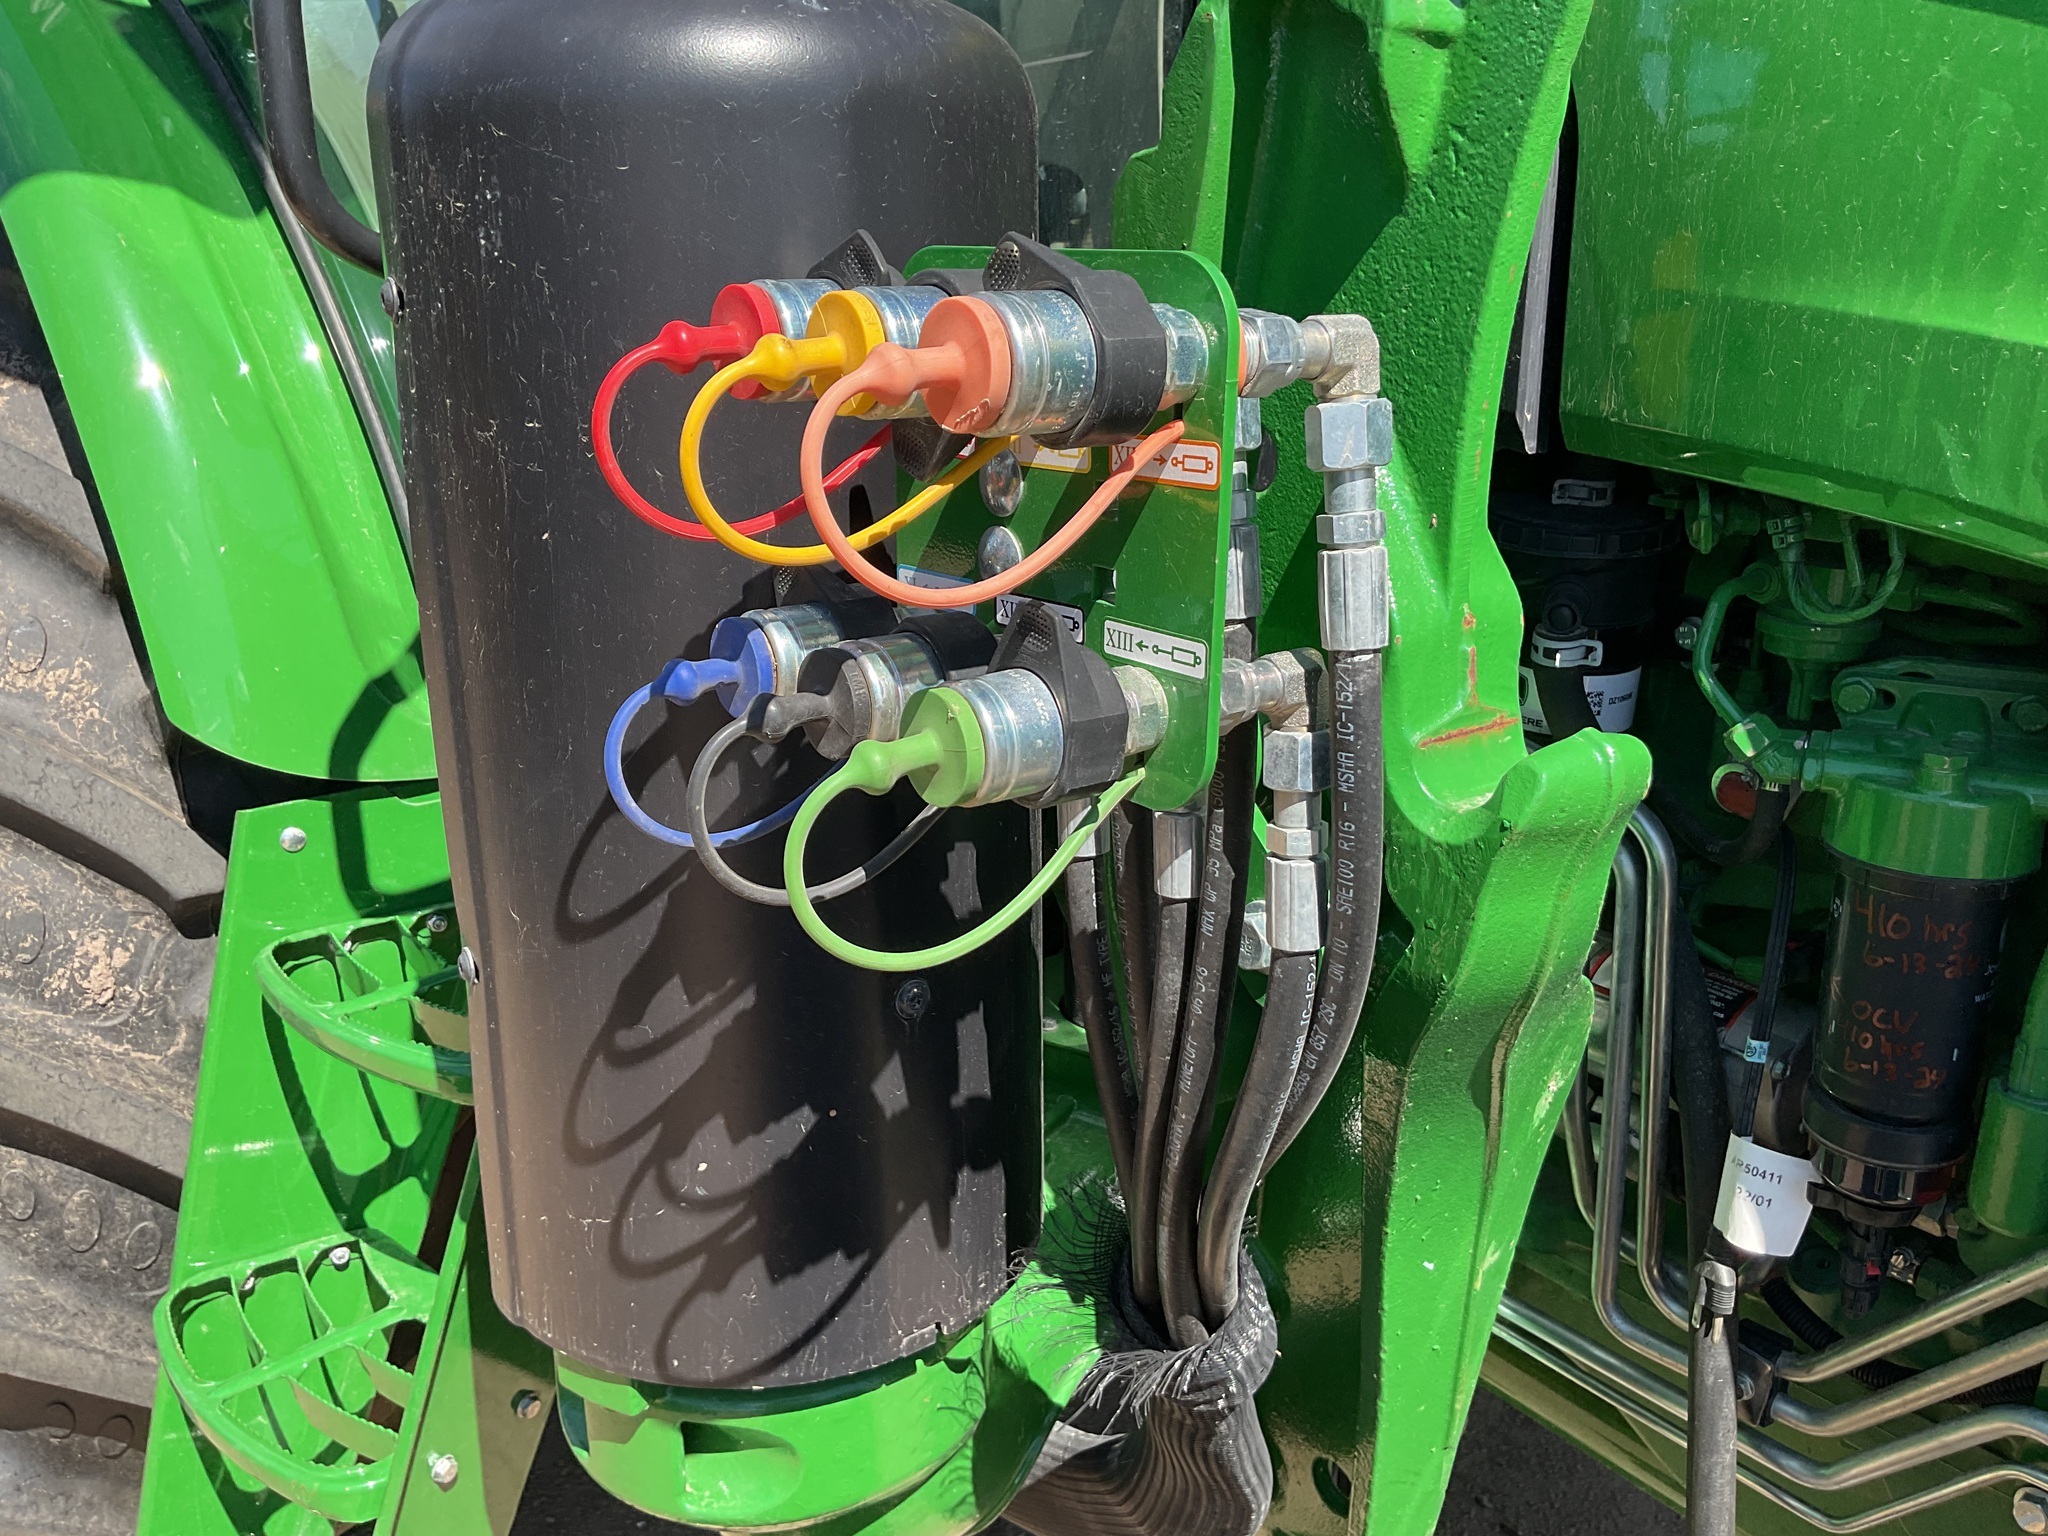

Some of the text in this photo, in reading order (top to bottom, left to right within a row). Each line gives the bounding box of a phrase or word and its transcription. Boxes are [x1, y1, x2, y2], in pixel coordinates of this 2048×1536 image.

[1105, 627, 1134, 655] XIII
[1337, 752, 1355, 793] MSHA
[1208, 823, 1223, 852] MPa
[1338, 820, 1356, 851] R16
[1205, 858, 1220, 878] 35
[1336, 858, 1355, 915] SAE100
[1200, 909, 1216, 937] MAX
[1854, 888, 1911, 940] 410
[1923, 914, 1974, 950] hrs
[1331, 937, 1349, 954] 10
[1328, 959, 1346, 984] DN
[1317, 997, 1338, 1026] 2SC
[1310, 1024, 1328, 1051] 857
[1177, 1035, 1199, 1095] MINETUFF
[1289, 1035, 1306, 1070] MSHA
[1303, 1049, 1319, 1070] EN
